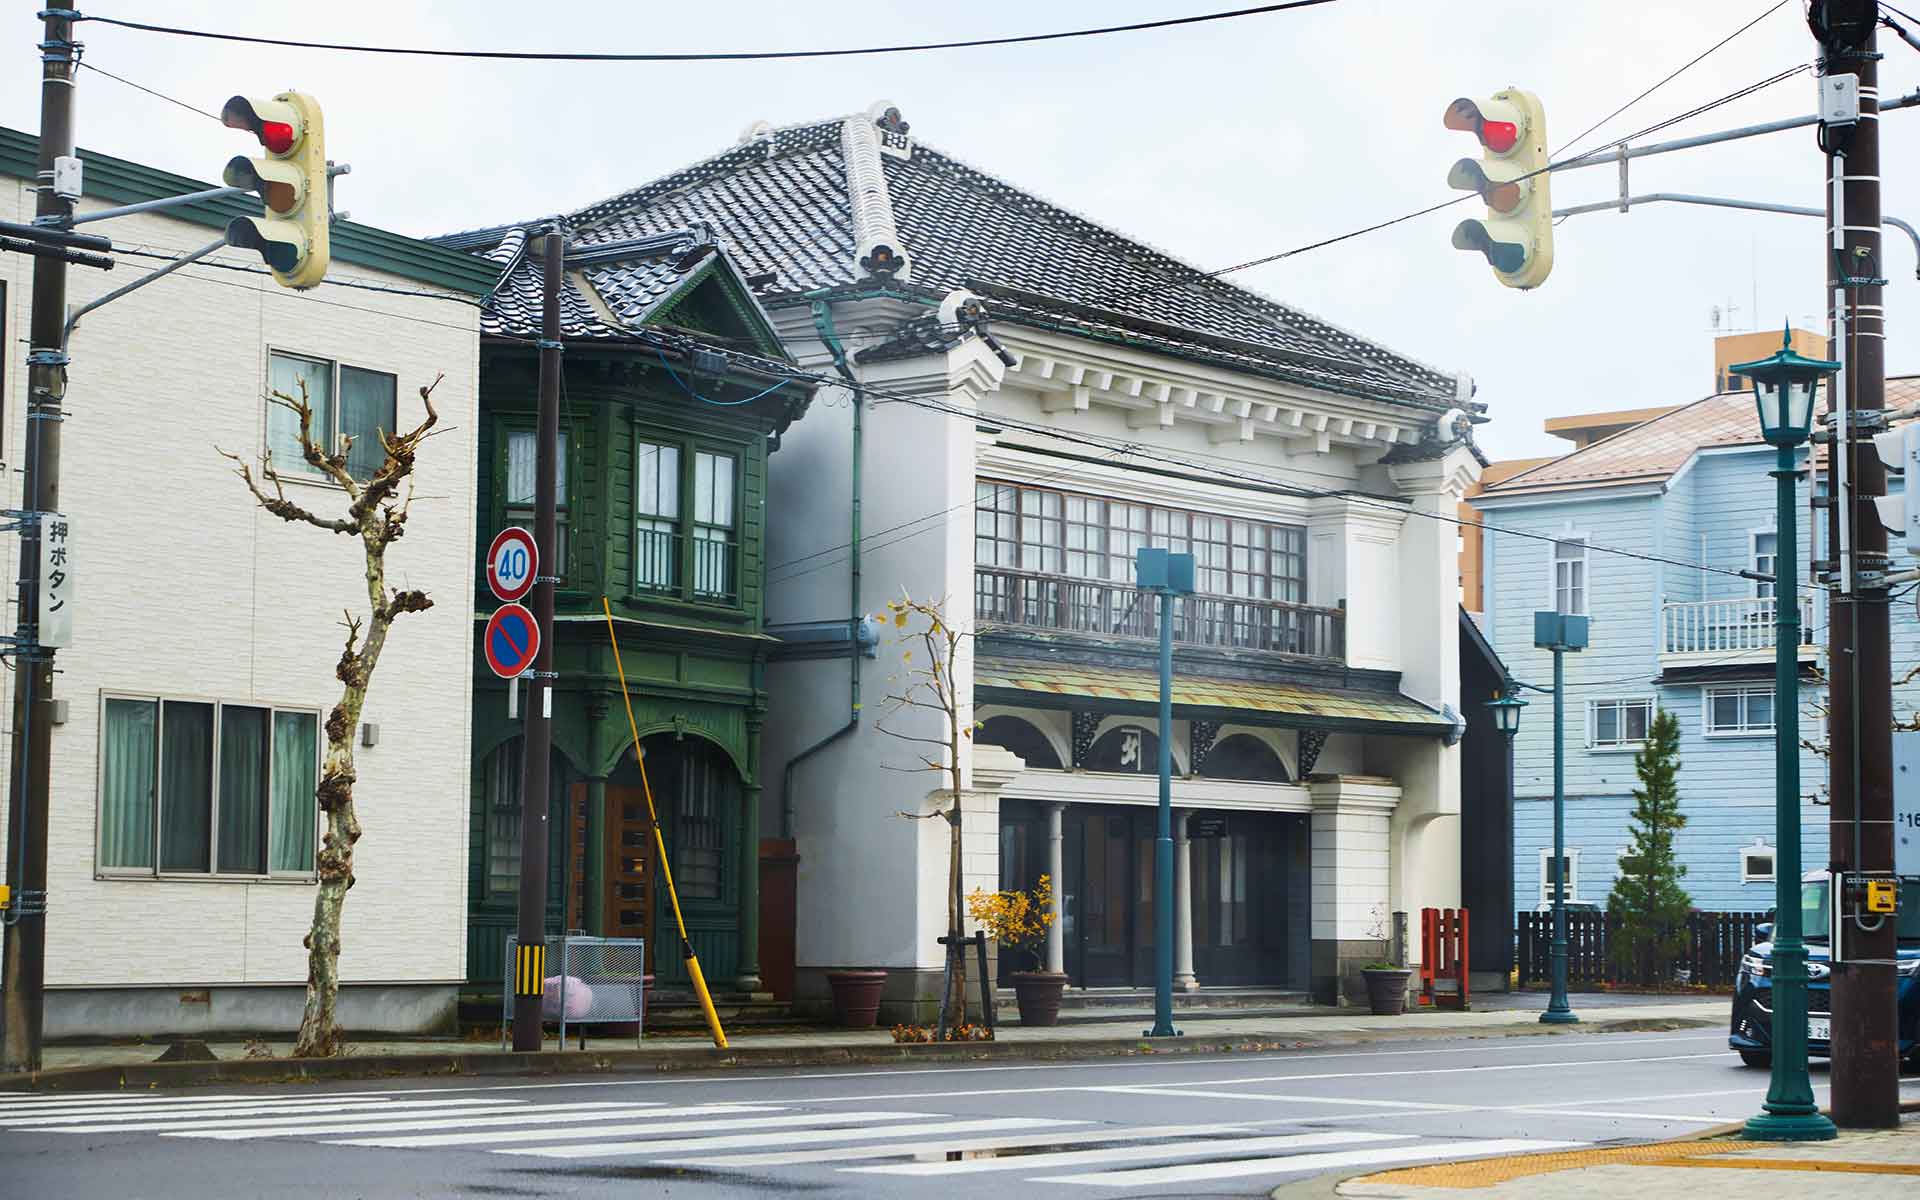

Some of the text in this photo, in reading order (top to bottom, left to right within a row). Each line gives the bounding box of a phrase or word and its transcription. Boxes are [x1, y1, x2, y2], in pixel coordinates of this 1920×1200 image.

[49, 521, 68, 612] 押ボタン
[499, 548, 526, 580] 40
